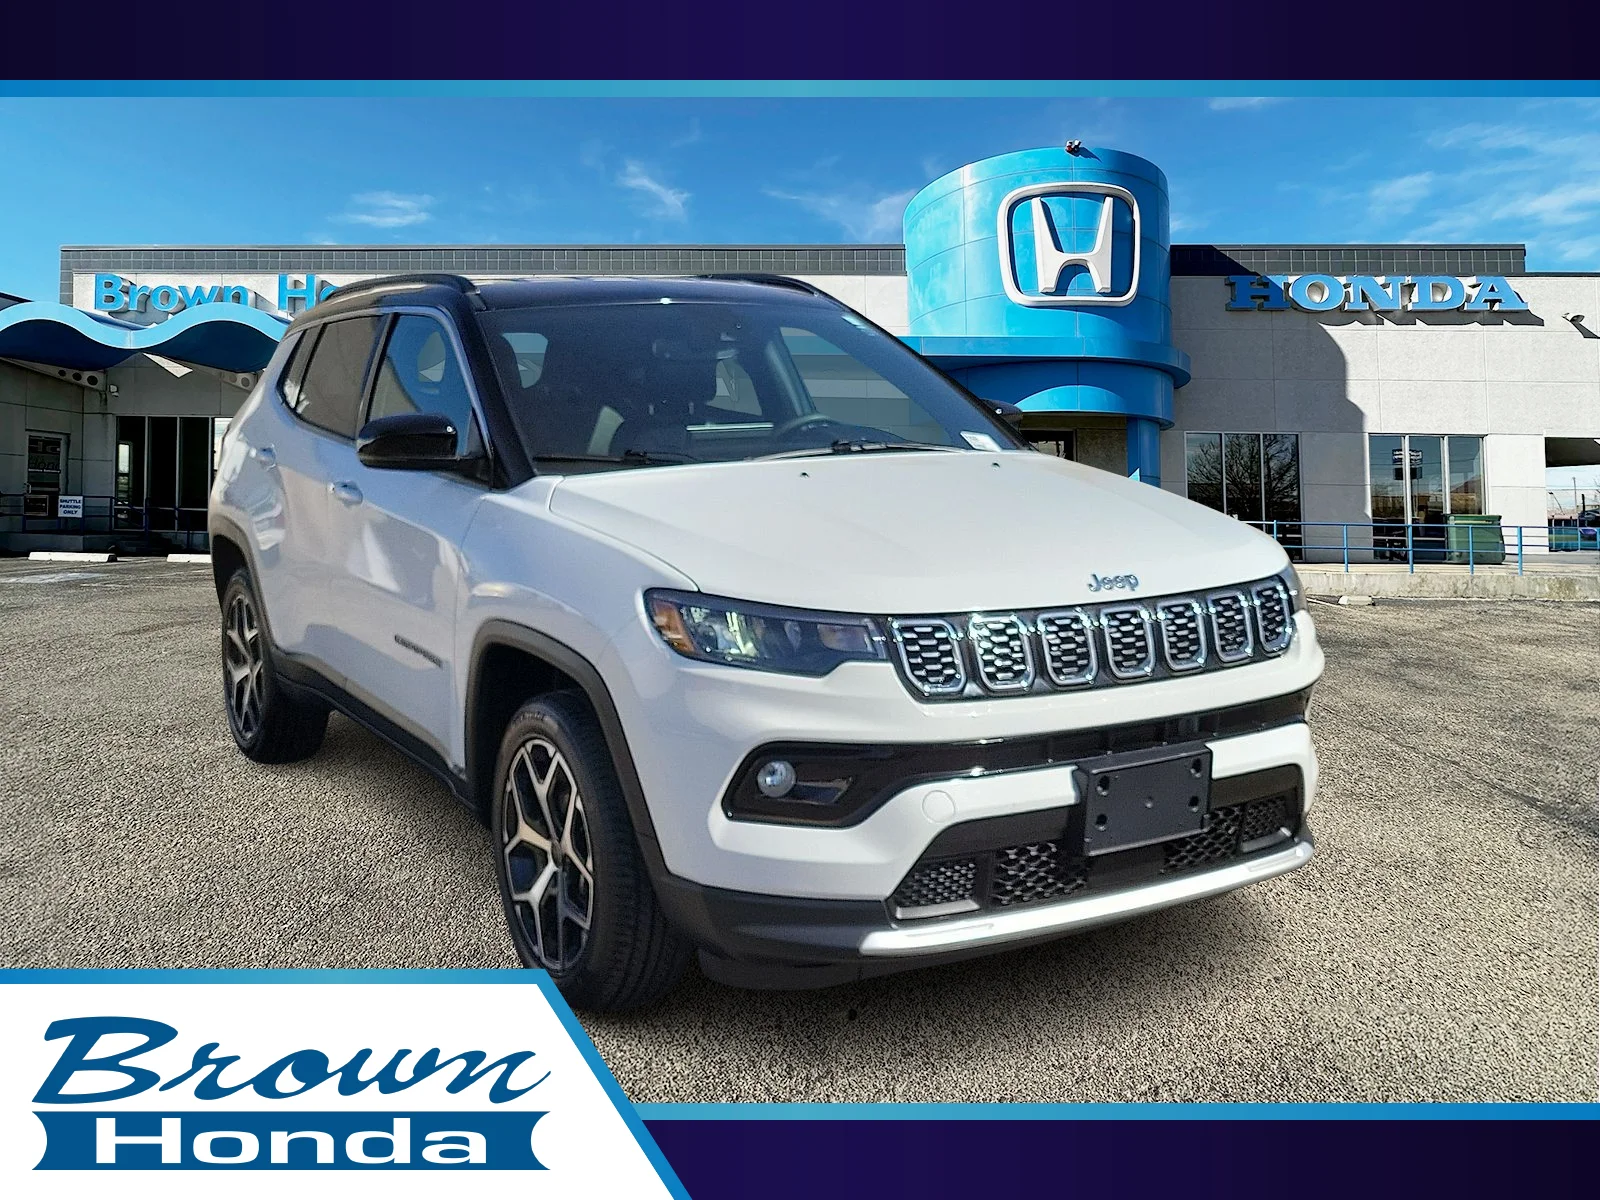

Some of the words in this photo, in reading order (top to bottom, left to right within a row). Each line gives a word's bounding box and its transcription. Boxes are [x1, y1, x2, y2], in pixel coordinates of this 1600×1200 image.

[94, 273, 249, 311] Brown
[1227, 273, 1529, 311] HONDA
[1087, 573, 1139, 592] Jeep
